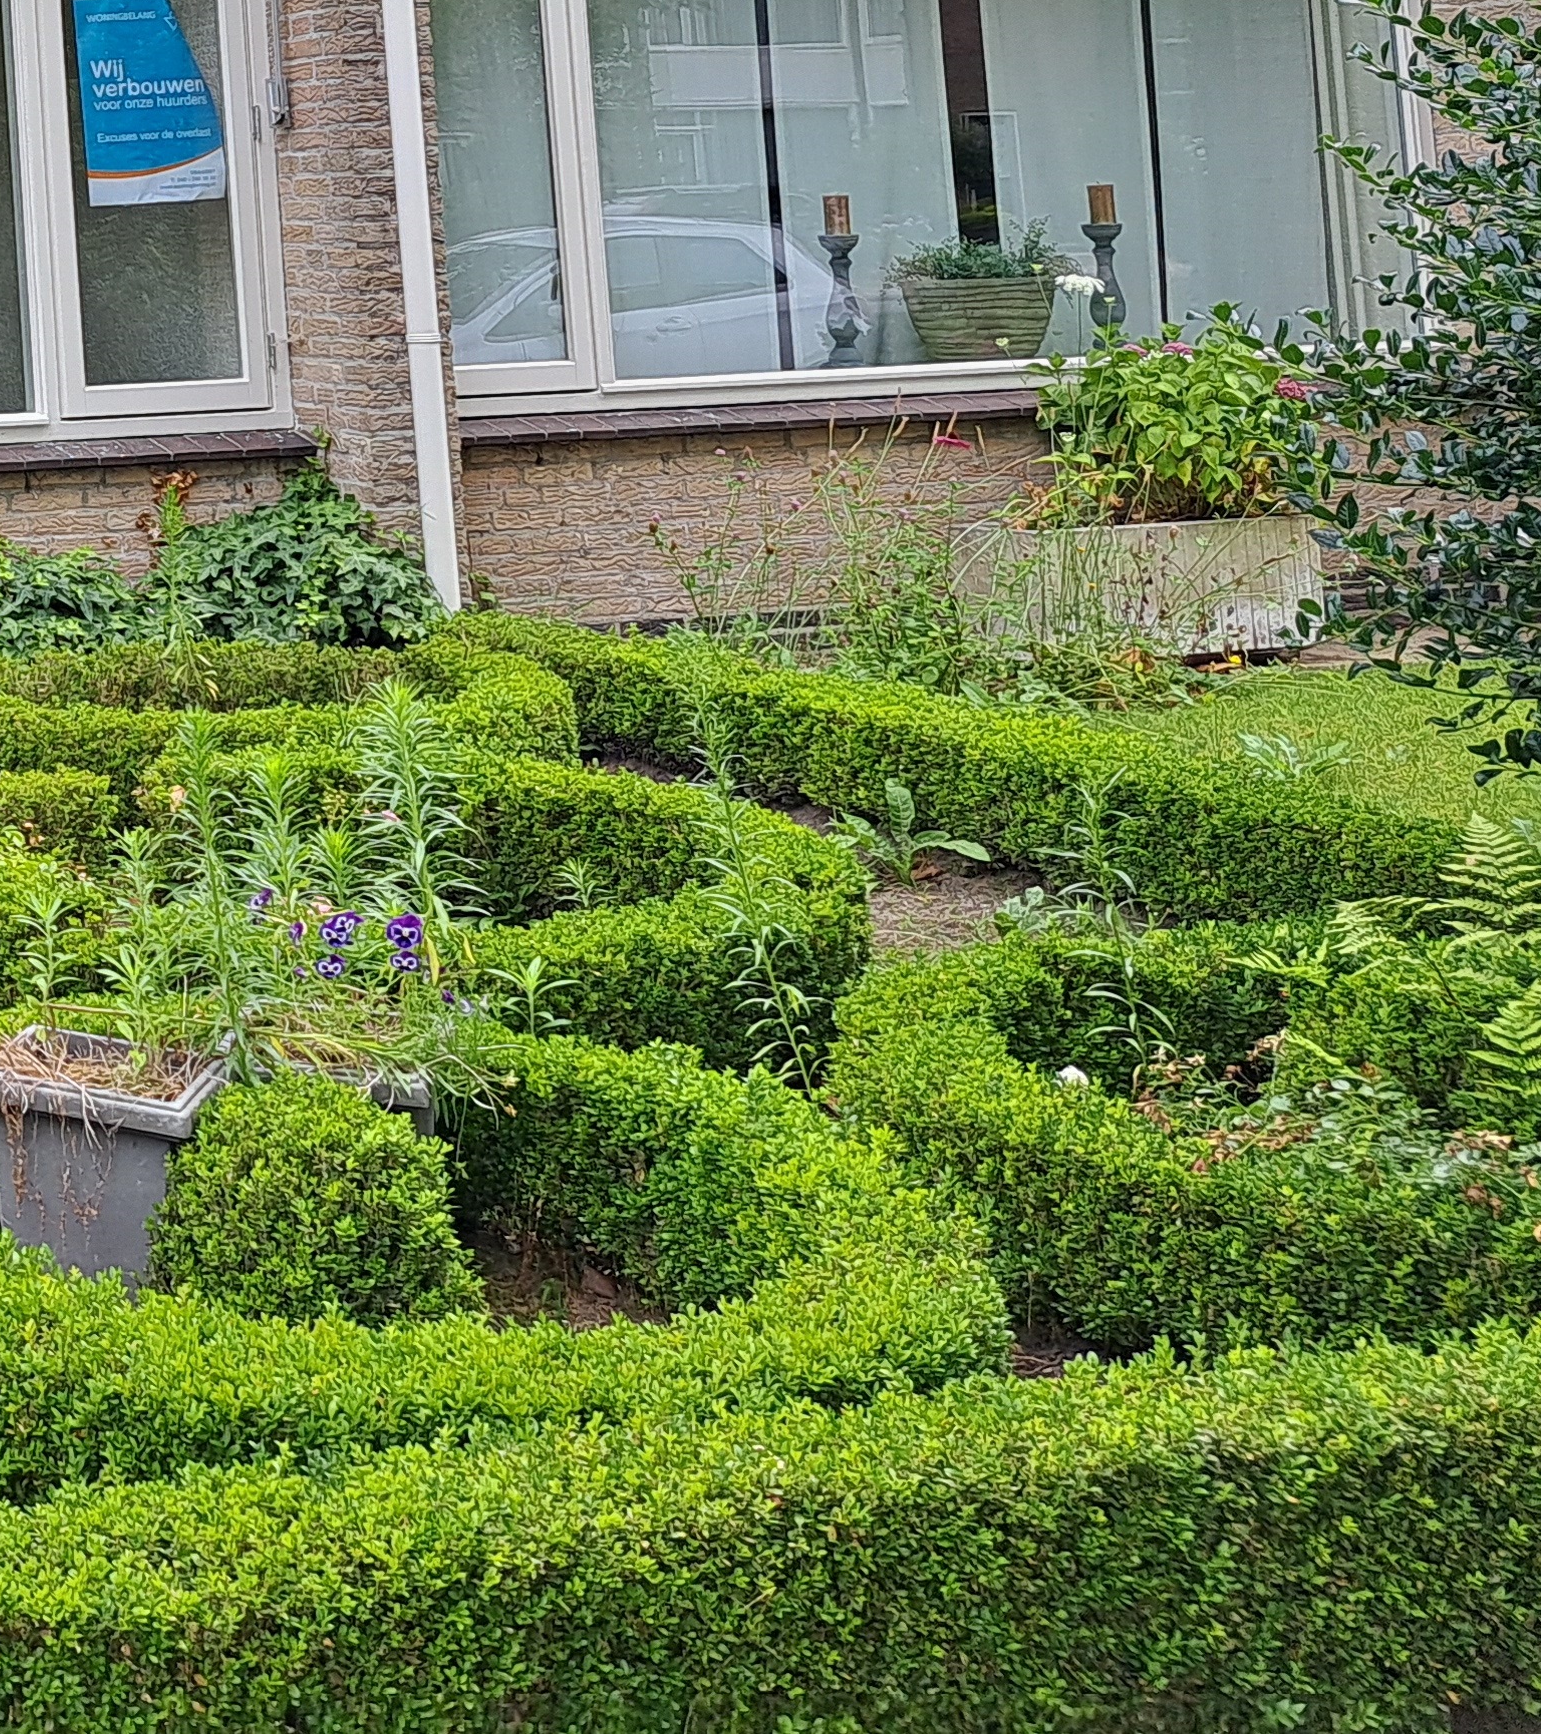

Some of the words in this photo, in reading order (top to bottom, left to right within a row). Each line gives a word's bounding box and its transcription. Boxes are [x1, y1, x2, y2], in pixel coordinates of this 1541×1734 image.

[86, 11, 156, 22] WONINGBELANG
[90, 59, 123, 81] Wij
[92, 78, 205, 98] verbouwen
[93, 100, 122, 110] voor
[124, 98, 154, 109] onze
[157, 94, 208, 107] huurders
[97, 133, 138, 143] Excuses
[139, 131, 160, 140] voor
[161, 129, 174, 139] de
